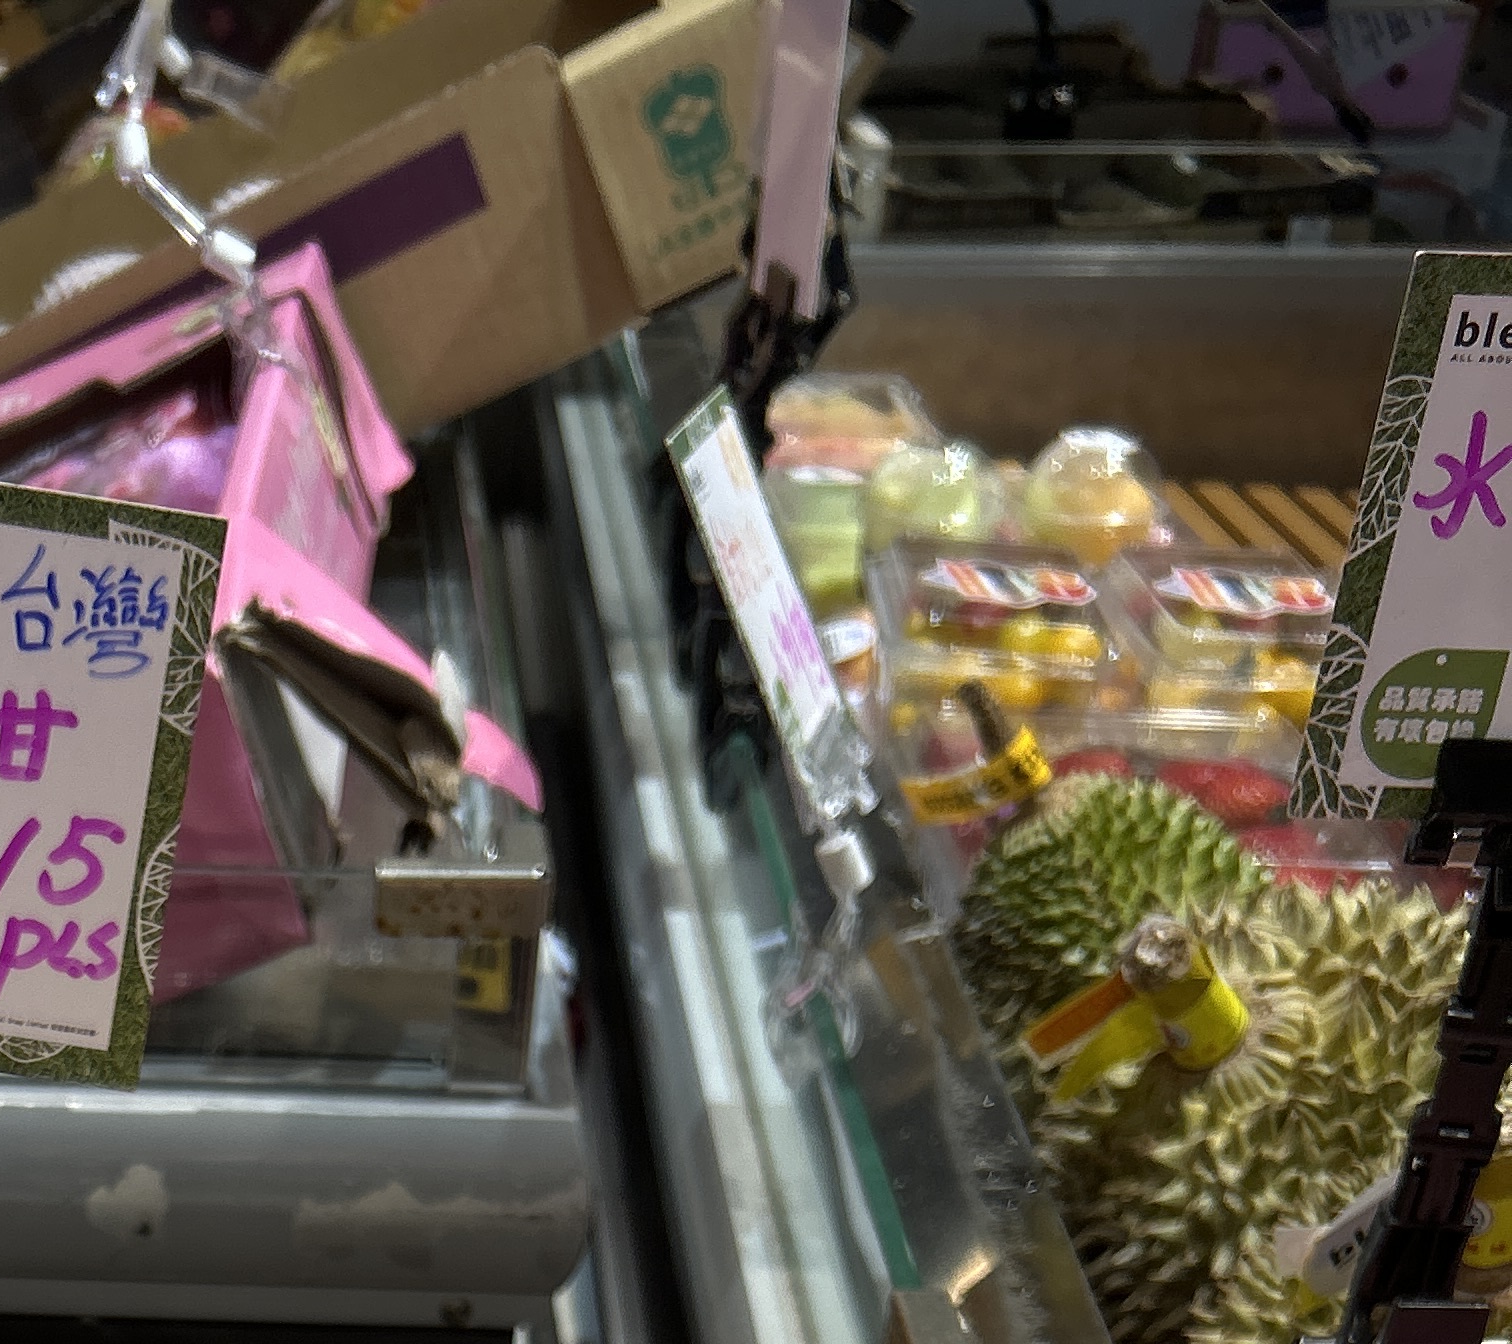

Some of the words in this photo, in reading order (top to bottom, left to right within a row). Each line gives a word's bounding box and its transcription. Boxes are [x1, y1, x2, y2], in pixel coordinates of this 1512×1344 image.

[1453, 311, 1512, 348] ble
[1478, 353, 1512, 365] ABOU
[0, 543, 170, 679] 台灣
